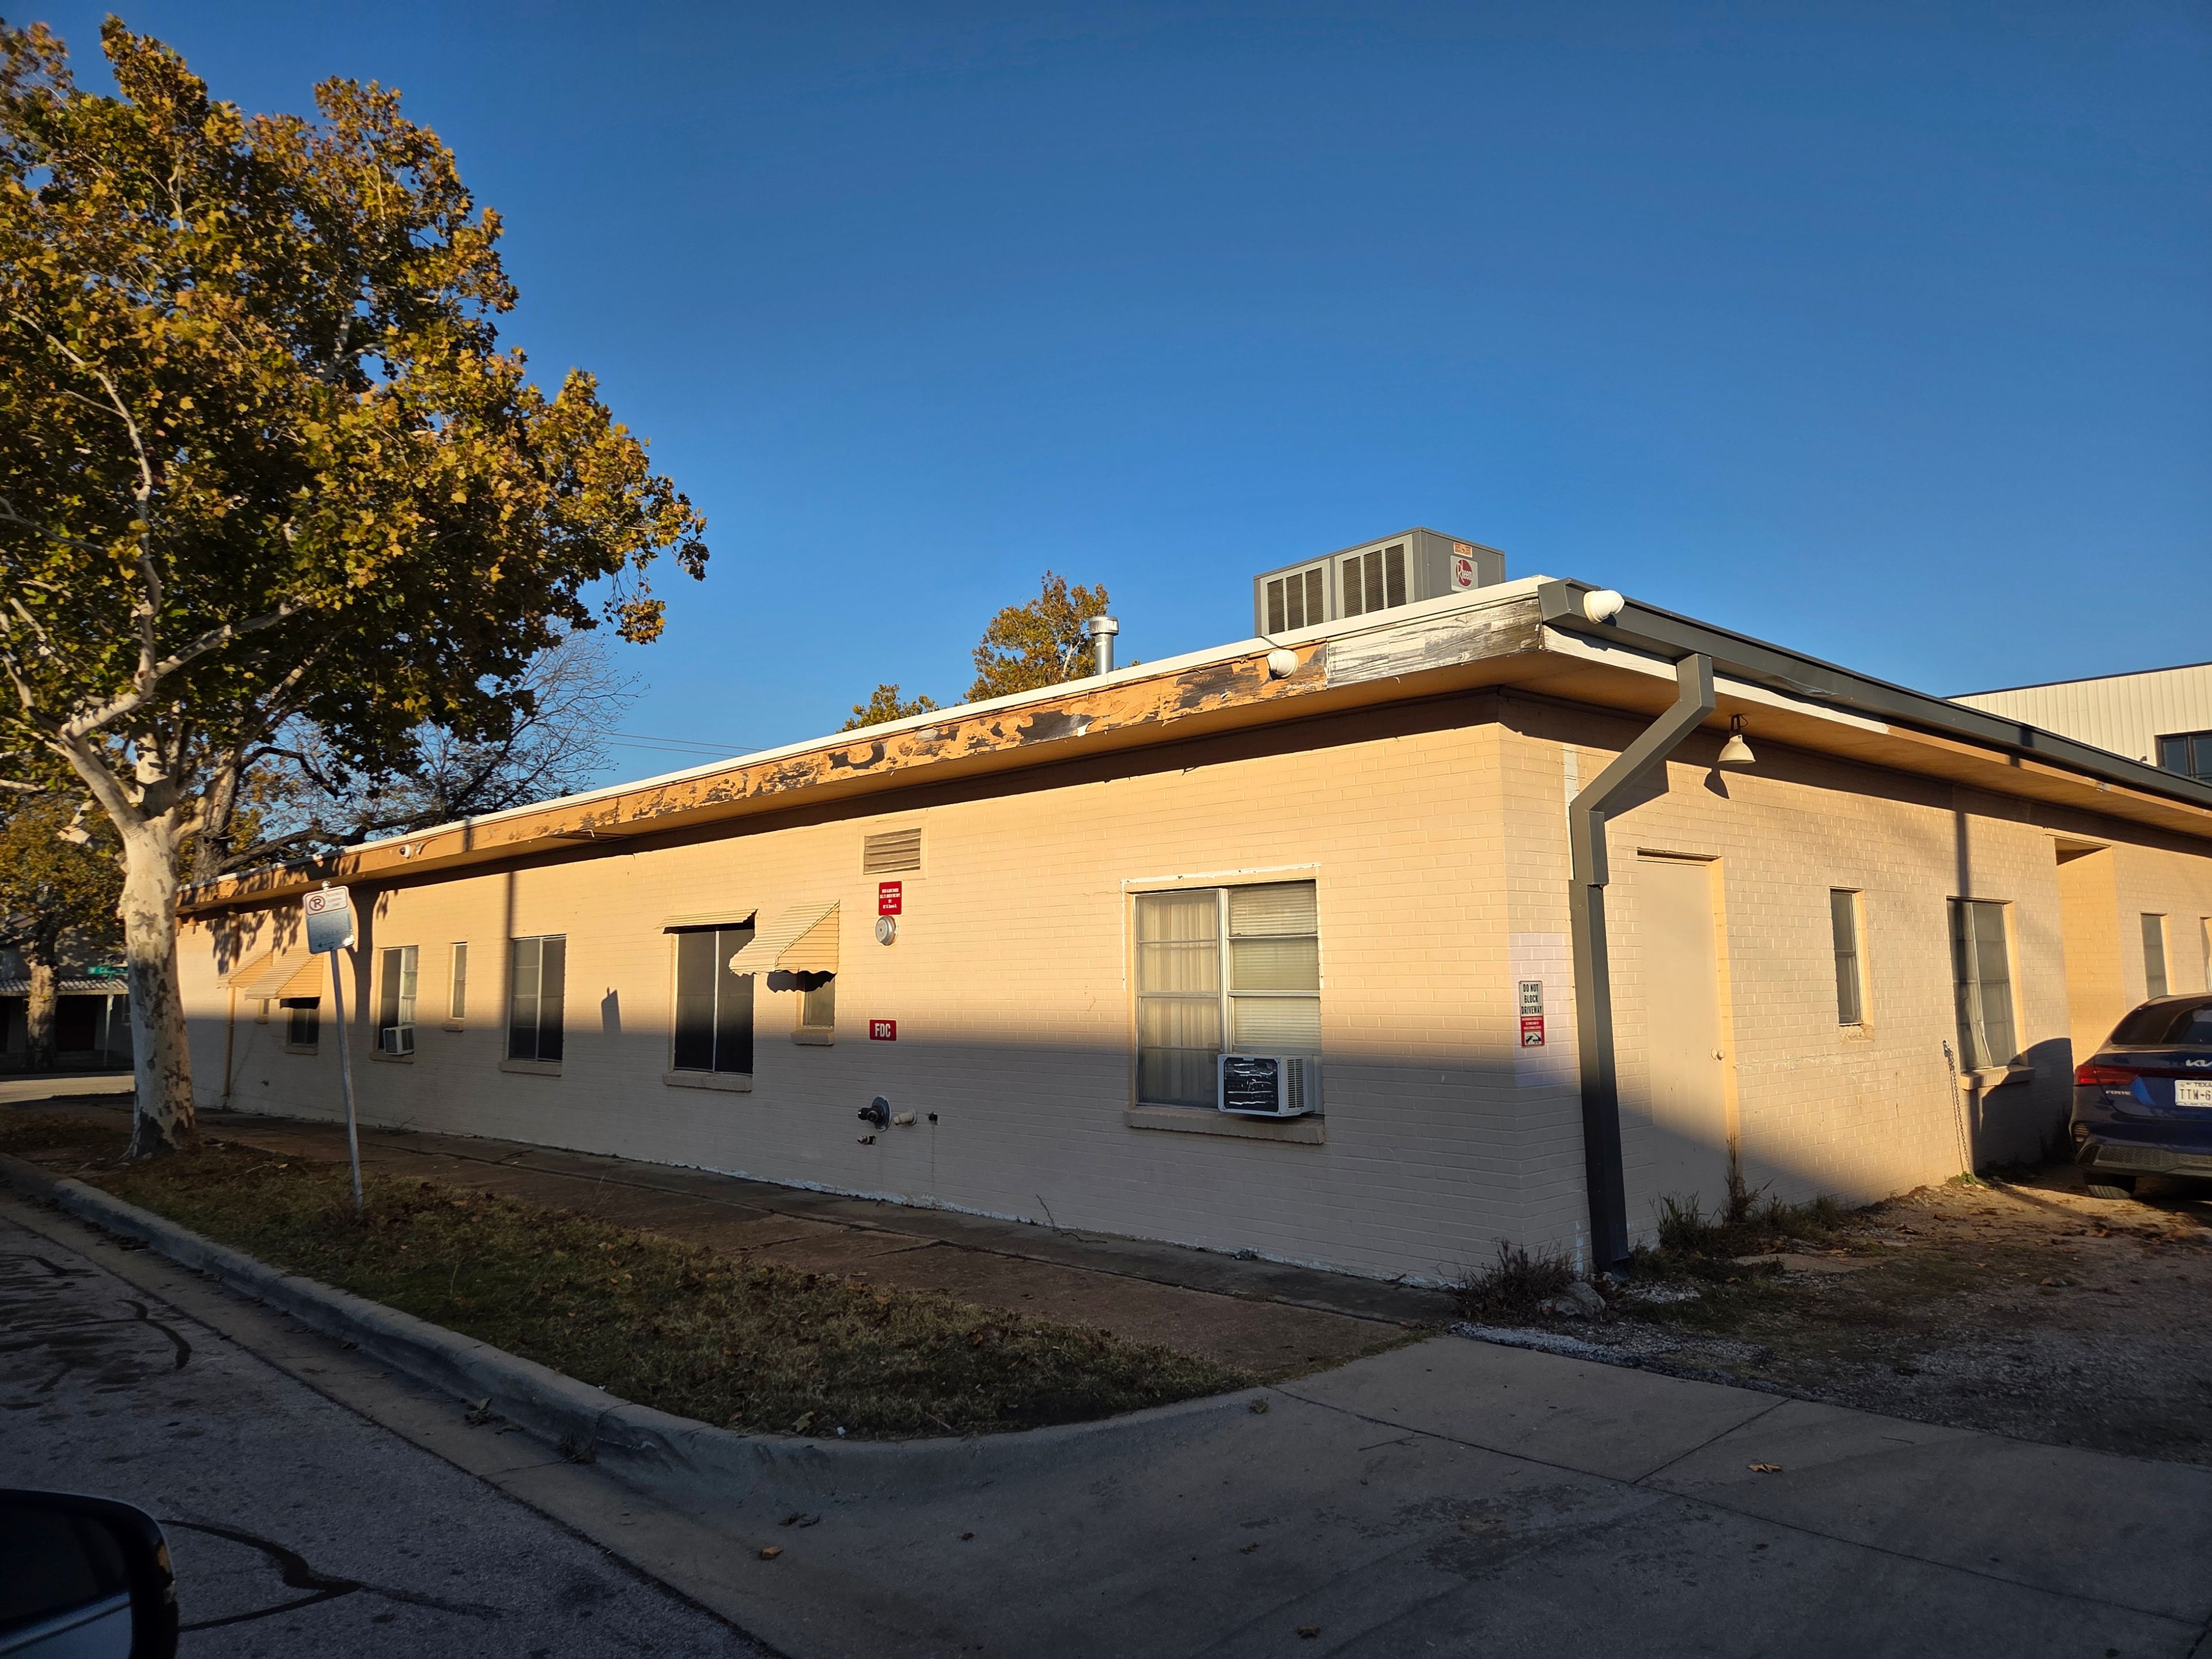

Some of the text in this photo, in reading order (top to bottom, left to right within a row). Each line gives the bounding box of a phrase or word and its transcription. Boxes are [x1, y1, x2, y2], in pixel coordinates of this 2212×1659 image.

[1523, 984, 1539, 992] DO NOT
[1524, 995, 1539, 1003] BLOCK
[1521, 1006, 1542, 1014] DRIVEWAY
[874, 1023, 891, 1037] FDC
